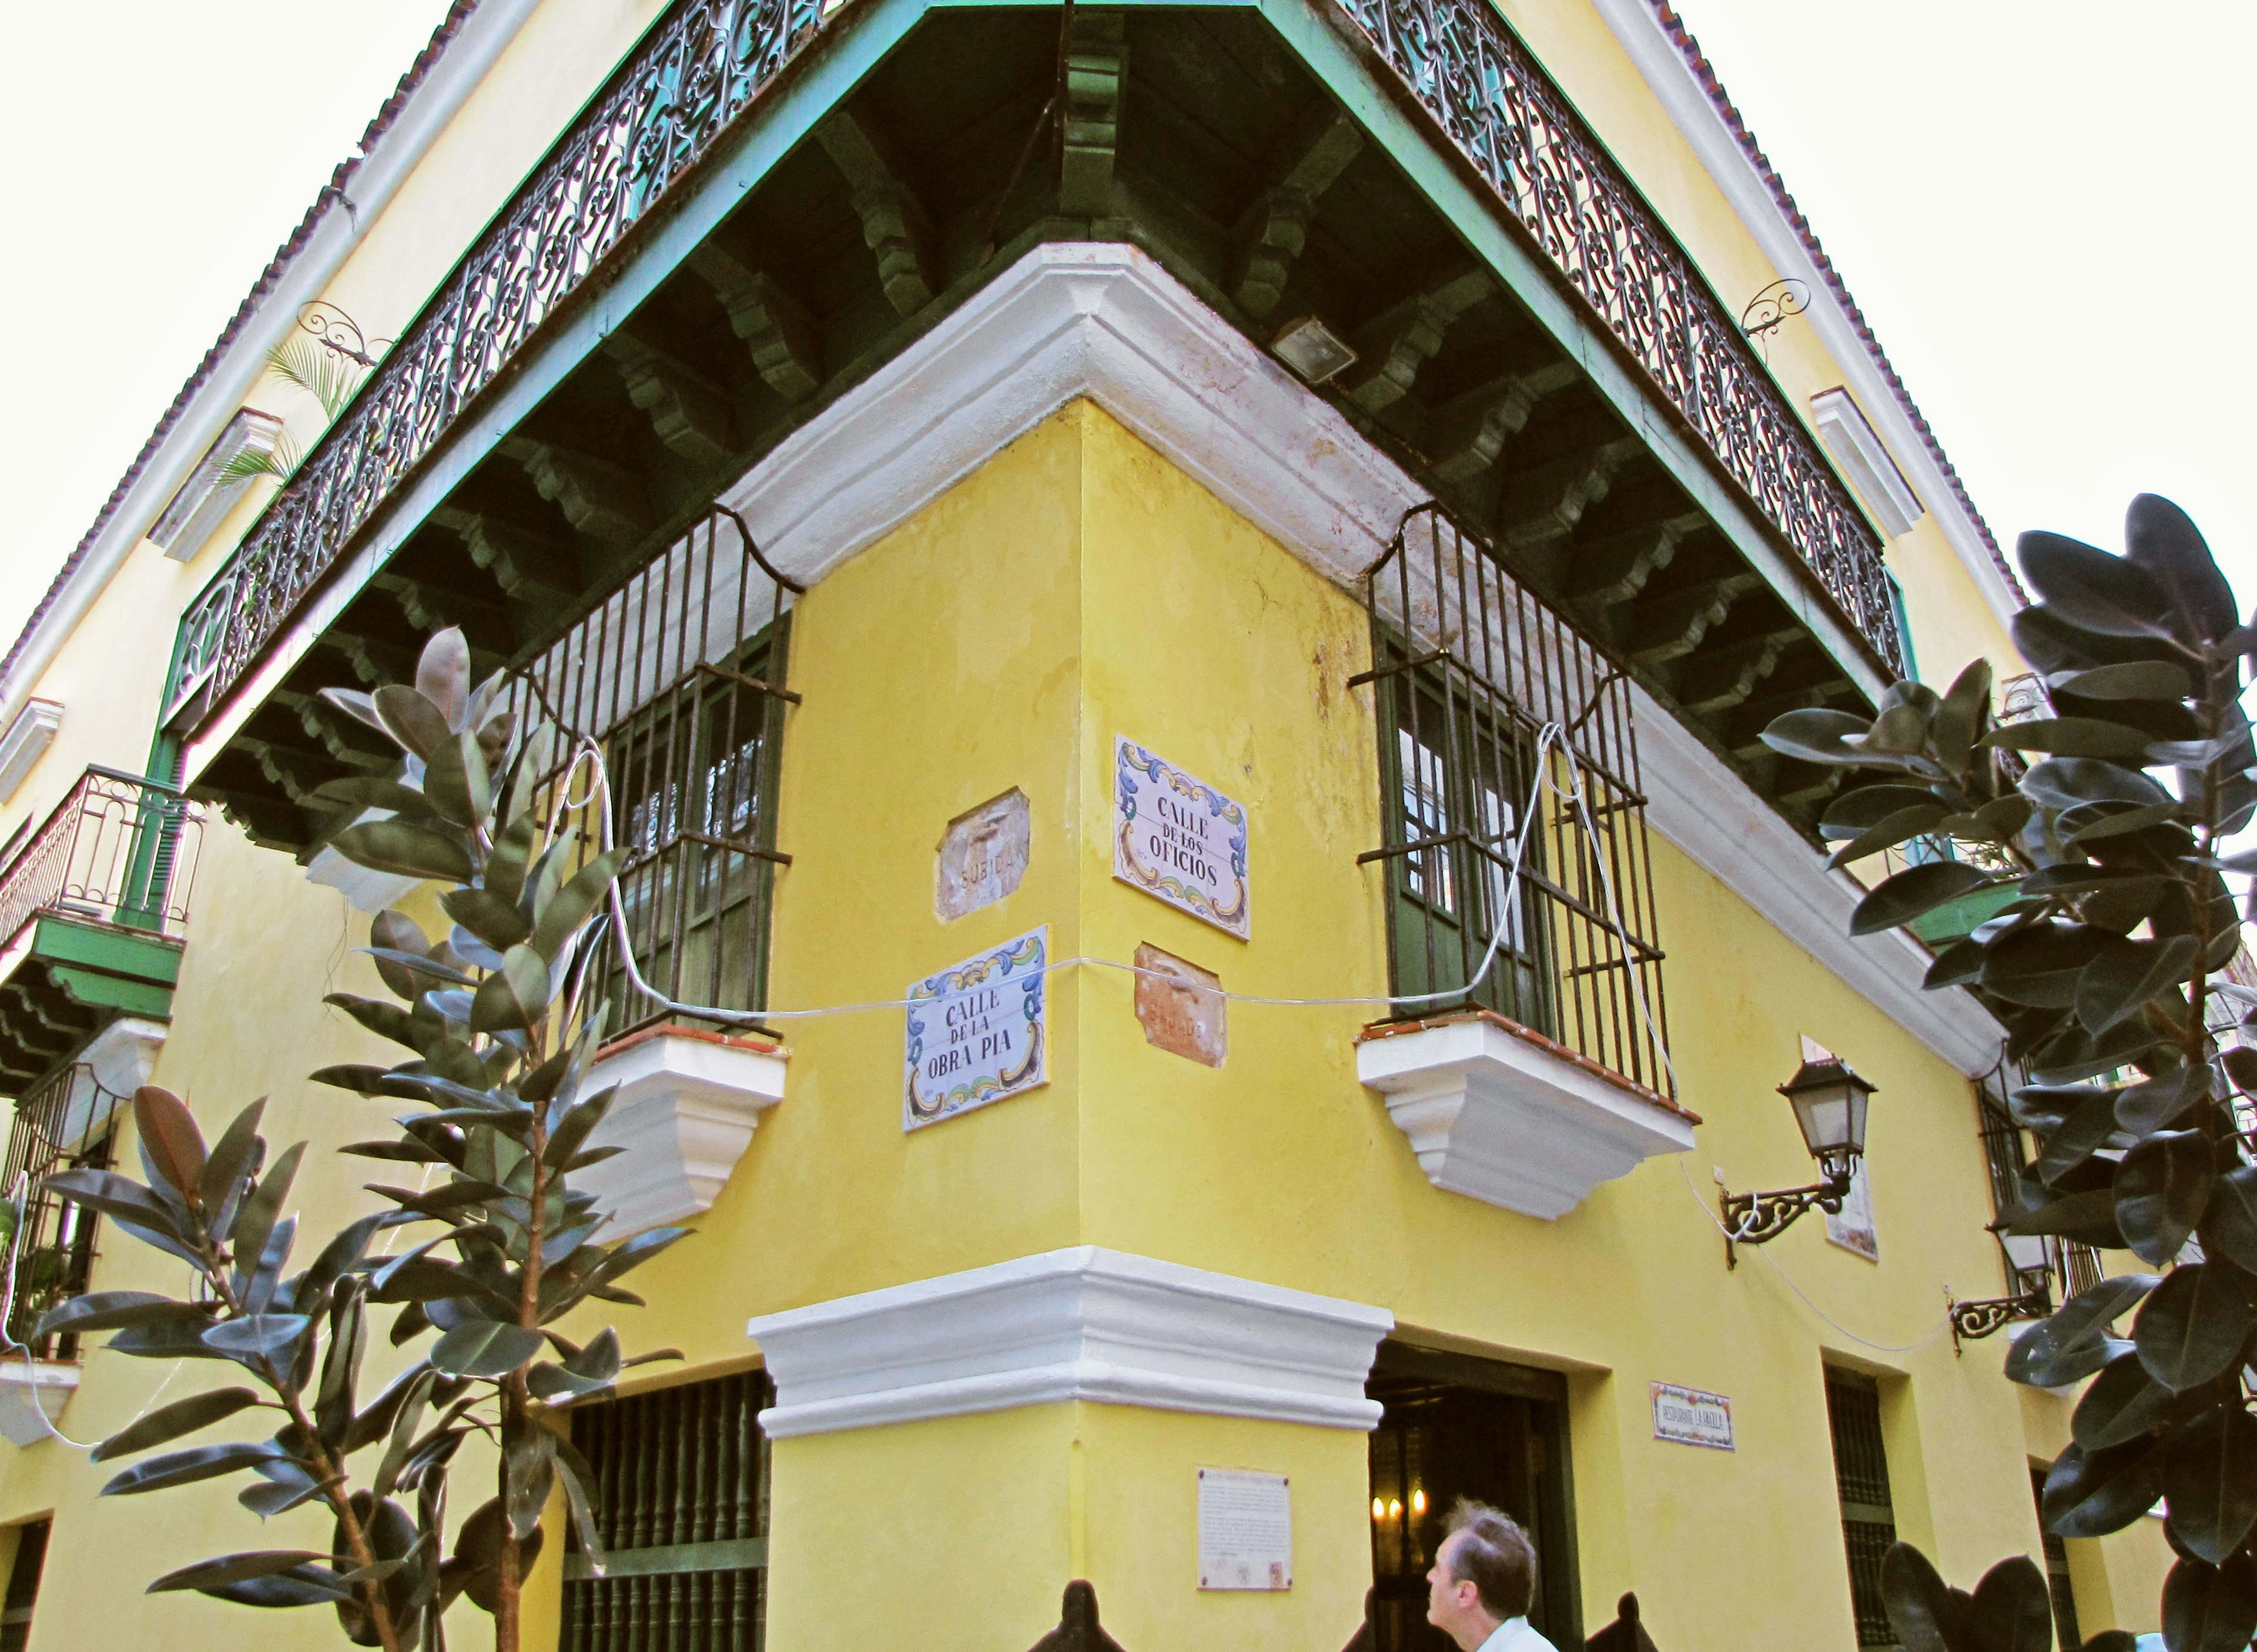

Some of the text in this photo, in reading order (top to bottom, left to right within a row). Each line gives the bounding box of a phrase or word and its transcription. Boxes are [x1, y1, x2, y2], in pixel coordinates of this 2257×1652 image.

[1157, 796, 1208, 840] CALLE
[1163, 822, 1203, 855] DE LOS
[962, 849, 1015, 889] SUBIDA
[1150, 835, 1217, 886] OFICIOS
[946, 990, 1000, 1026] CALLE
[950, 1015, 990, 1045] DE LA
[928, 1028, 1012, 1079] OBRA PIA
